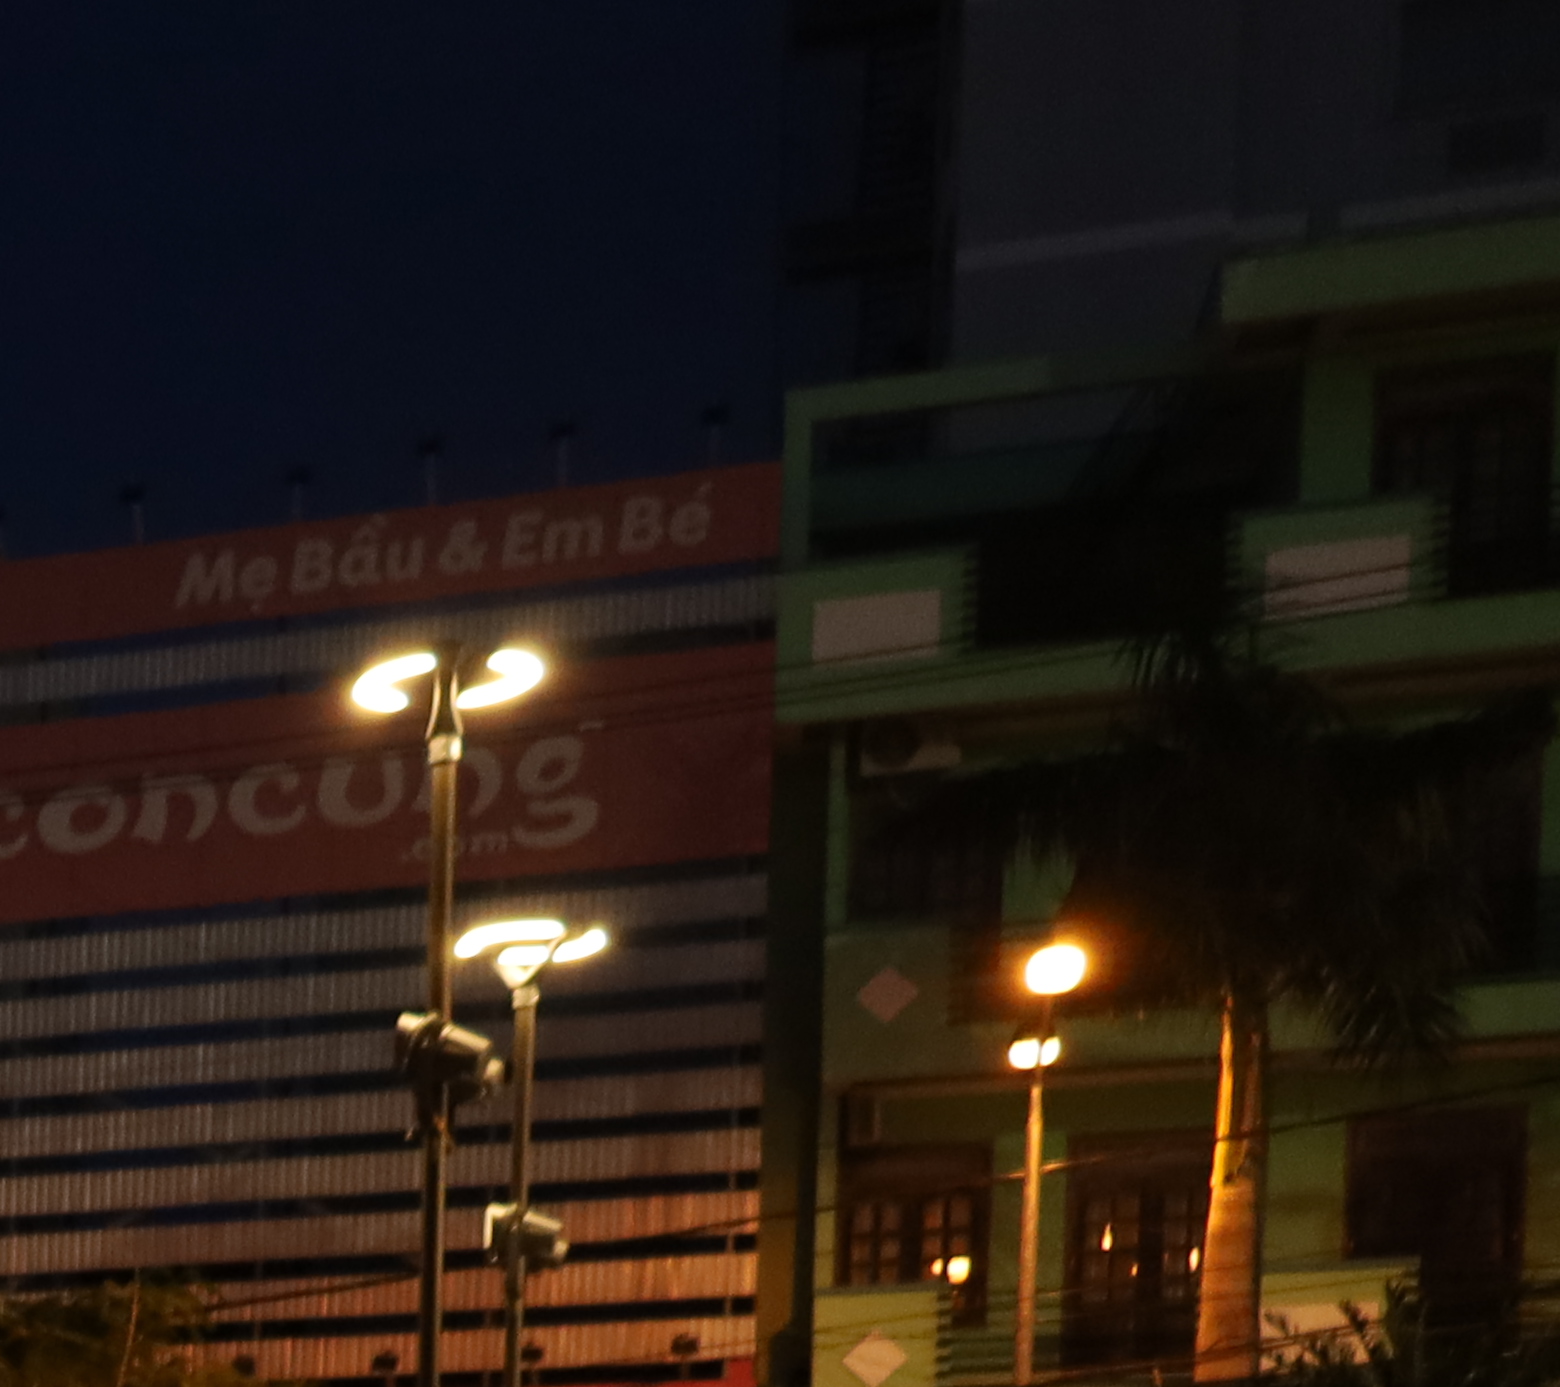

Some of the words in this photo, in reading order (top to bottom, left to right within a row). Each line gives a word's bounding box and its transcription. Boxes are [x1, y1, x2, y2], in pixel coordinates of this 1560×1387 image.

[176, 548, 277, 615] Mẹ
[438, 521, 488, 576] &
[501, 508, 603, 570] Em
[618, 481, 713, 554] Bé
